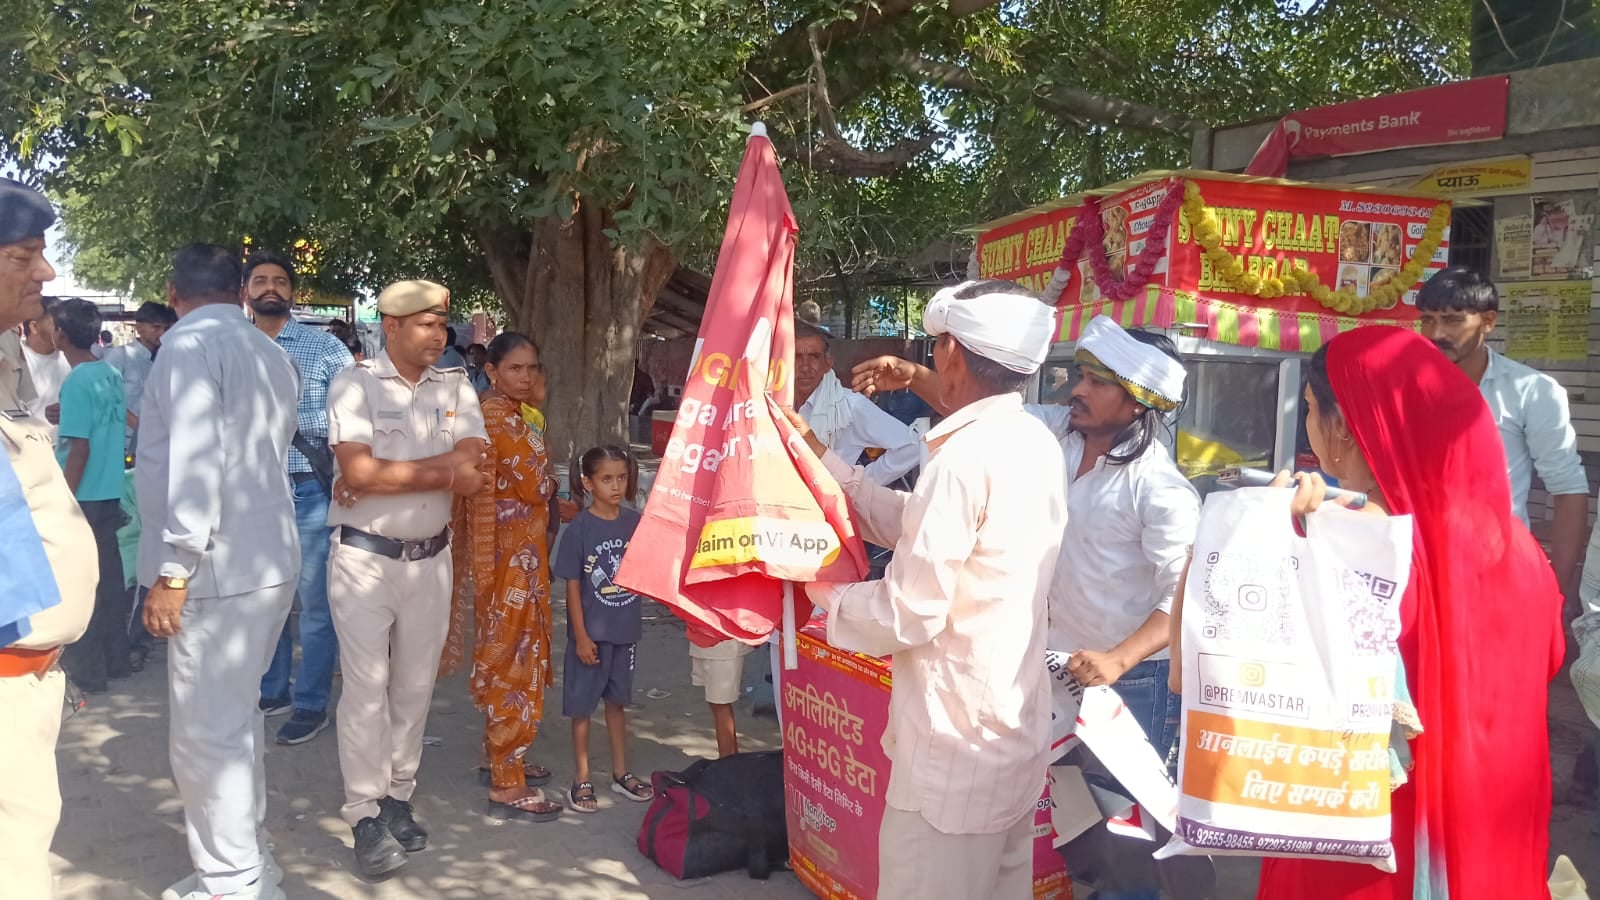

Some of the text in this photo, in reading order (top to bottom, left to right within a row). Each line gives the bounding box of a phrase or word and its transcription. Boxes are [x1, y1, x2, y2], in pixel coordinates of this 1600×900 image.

[1304, 111, 1421, 140] Payments Bank
[1437, 174, 1480, 188] प्याऊ
[1178, 205, 1339, 254] SNNY CHAAT
[980, 232, 1024, 278] SUNNY
[595, 538, 623, 555] POLO
[697, 534, 734, 554] laim
[739, 531, 763, 549] on
[789, 532, 829, 557] App
[785, 682, 864, 747] अनलिमिटेड
[786, 721, 877, 797] 4G+5G डेटा
[1240, 769, 1286, 804] लिए
[1196, 827, 1255, 849] 92555-98455
